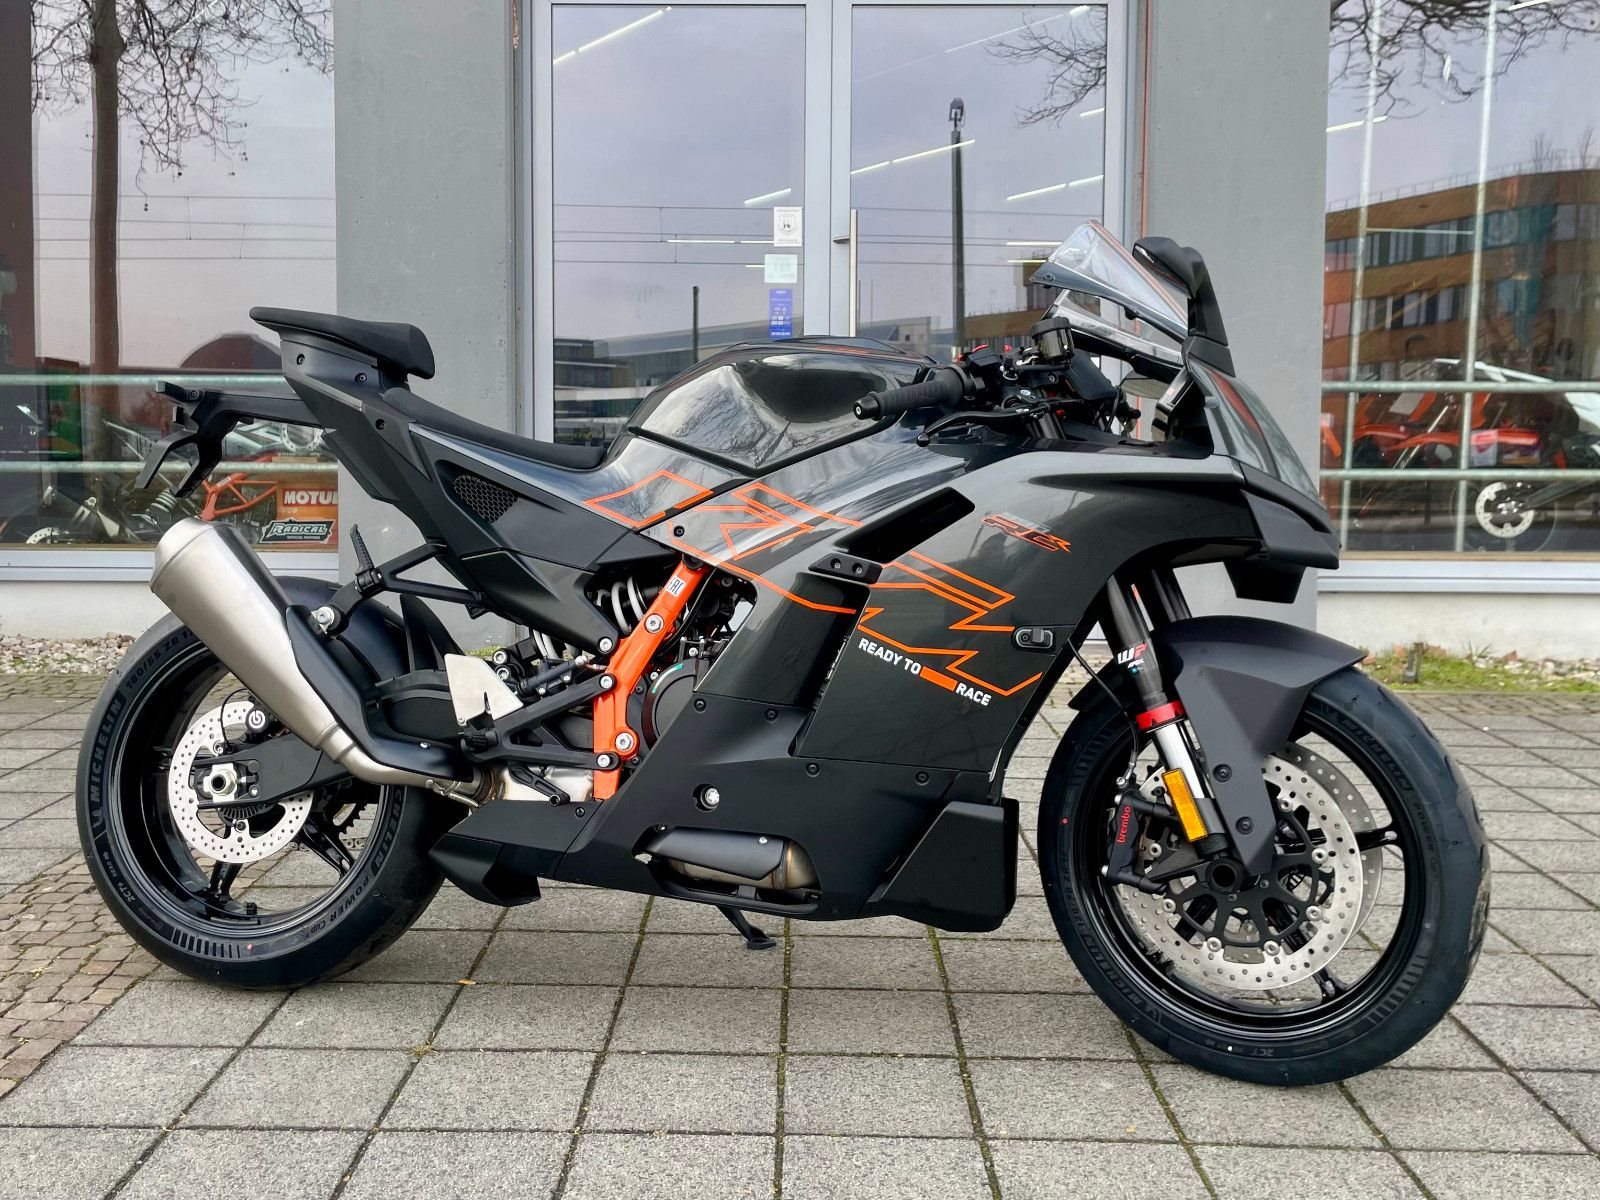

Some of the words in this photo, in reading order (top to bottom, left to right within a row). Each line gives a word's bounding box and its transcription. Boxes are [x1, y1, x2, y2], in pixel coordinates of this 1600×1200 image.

[272, 523, 326, 535] RADICAL
[858, 637, 904, 666] READY
[903, 657, 922, 676] TO
[954, 682, 993, 707] RACE
[1117, 642, 1148, 665] WP
[90, 698, 122, 802] MICHELIN
[1343, 719, 1411, 791] MICHELIN
[375, 788, 403, 869] CHELIN
[1116, 804, 1132, 845] brembo
[329, 876, 369, 922] POWER
[1084, 934, 1143, 1006] MICHELIN
